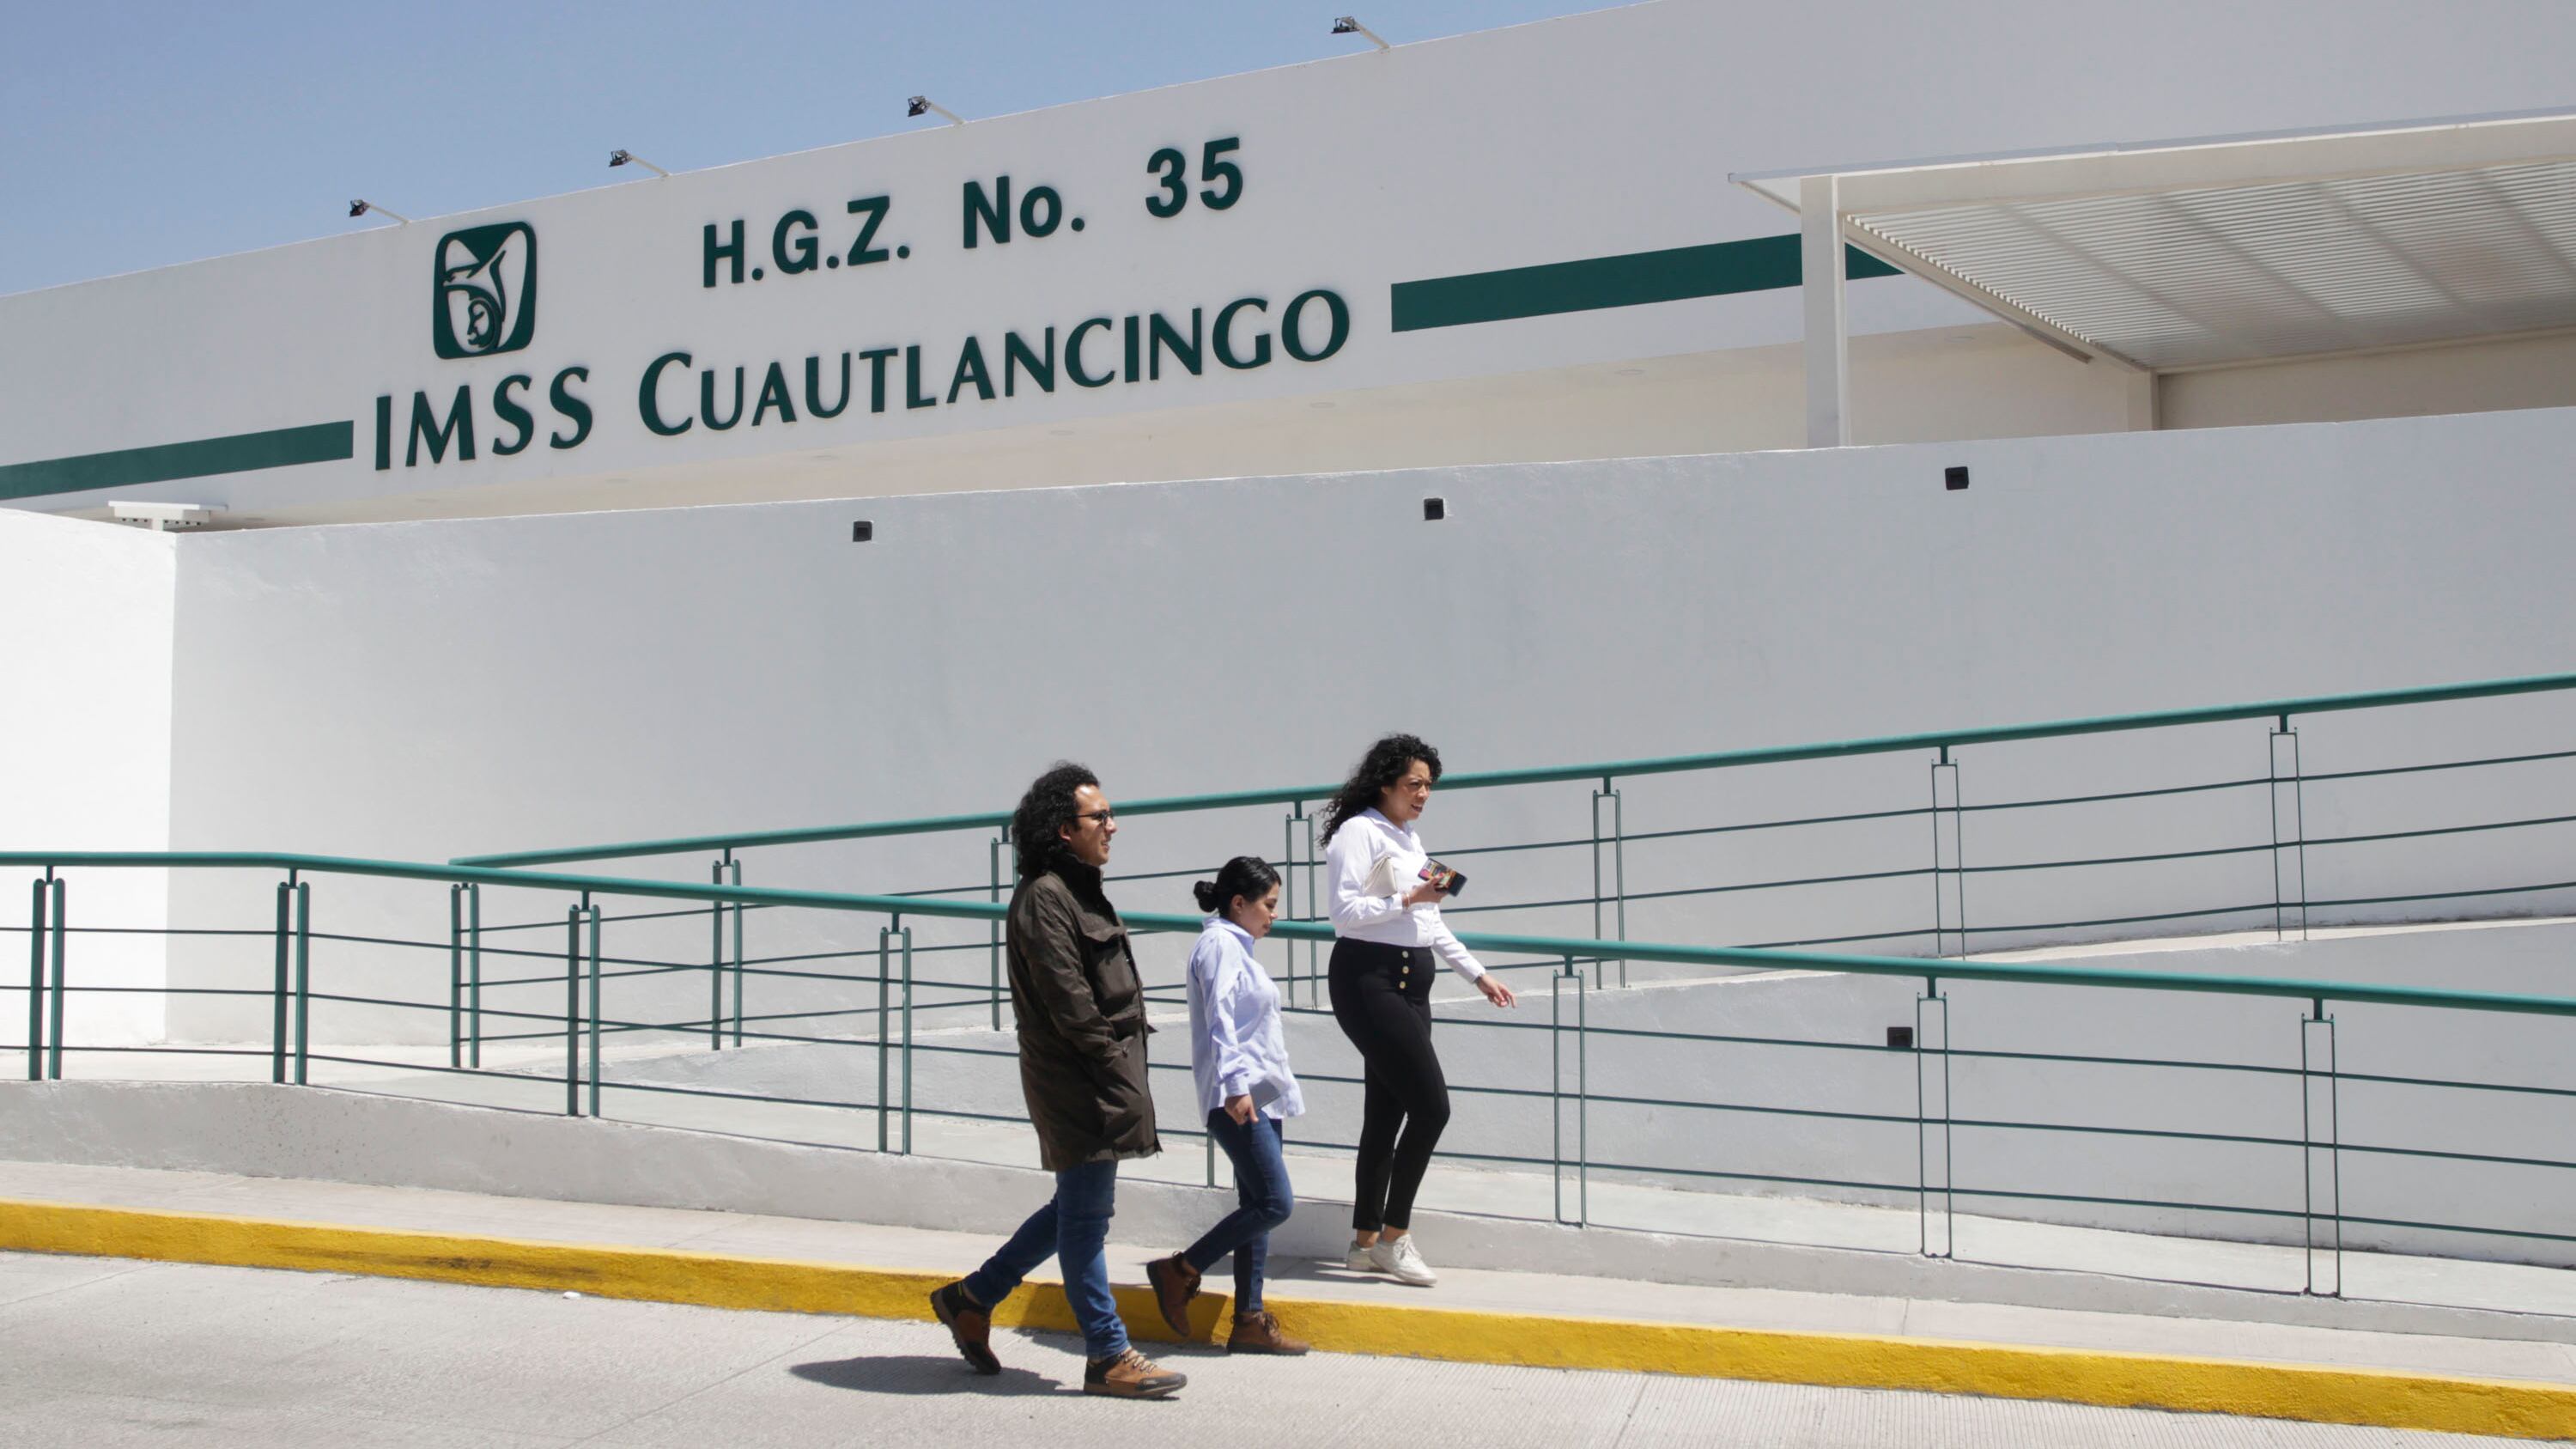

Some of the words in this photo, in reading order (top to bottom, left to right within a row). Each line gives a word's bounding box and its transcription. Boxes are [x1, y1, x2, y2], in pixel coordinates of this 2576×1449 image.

[703, 195, 910, 289] H.G.Z.
[963, 175, 1085, 250] No.
[1145, 136, 1243, 219] 35
[375, 366, 593, 472] IMSS
[638, 289, 1351, 436] CUAUTLANCINGO
